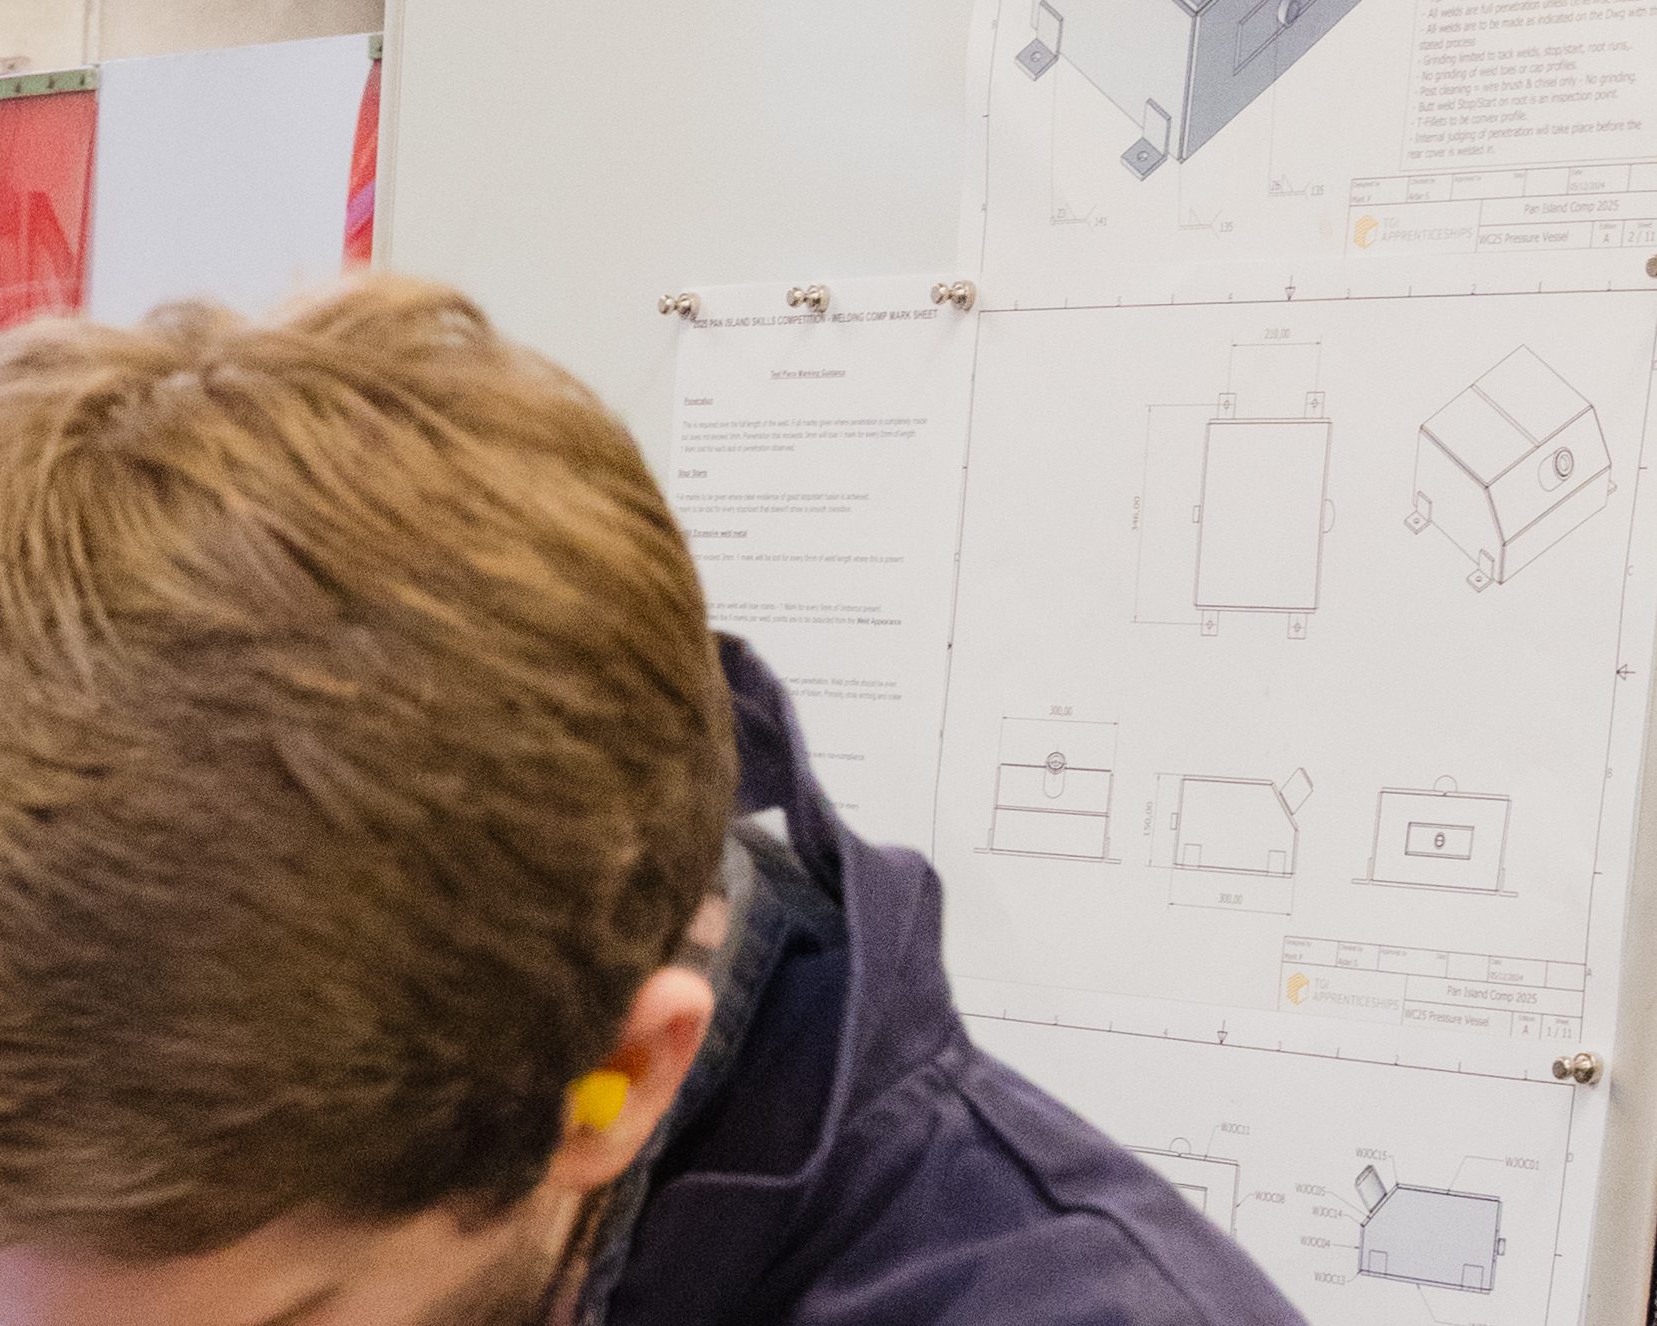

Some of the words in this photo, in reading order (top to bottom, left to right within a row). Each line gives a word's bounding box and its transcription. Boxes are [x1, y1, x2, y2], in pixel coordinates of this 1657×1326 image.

[1524, 203, 1538, 215] Pan
[1542, 202, 1567, 214] Island
[1570, 201, 1595, 215] Comp
[1597, 200, 1619, 212] 2025
[1381, 228, 1474, 241] APPRENTICESHIPS
[1479, 233, 1502, 244] WC25
[1505, 232, 1540, 243] Pressure
[1543, 231, 1569, 242] Vessel
[710, 318, 723, 328] PAN
[724, 317, 750, 328] ISLAND
[752, 316, 776, 326] SKILLS
[832, 312, 864, 323] WELDING
[866, 311, 887, 322] COMP
[889, 310, 911, 321] MARK
[913, 309, 937, 320] SHEET
[1312, 992, 1399, 1010] APPRENTICESHIPS
[1447, 985, 1461, 997] Pan
[1464, 987, 1487, 1000] Island
[1490, 989, 1514, 1003] Comp
[1516, 991, 1537, 1004] 2025
[1404, 1009, 1427, 1021] WC25
[1428, 1012, 1463, 1025] Pressure
[1465, 1015, 1488, 1027] Vessel
